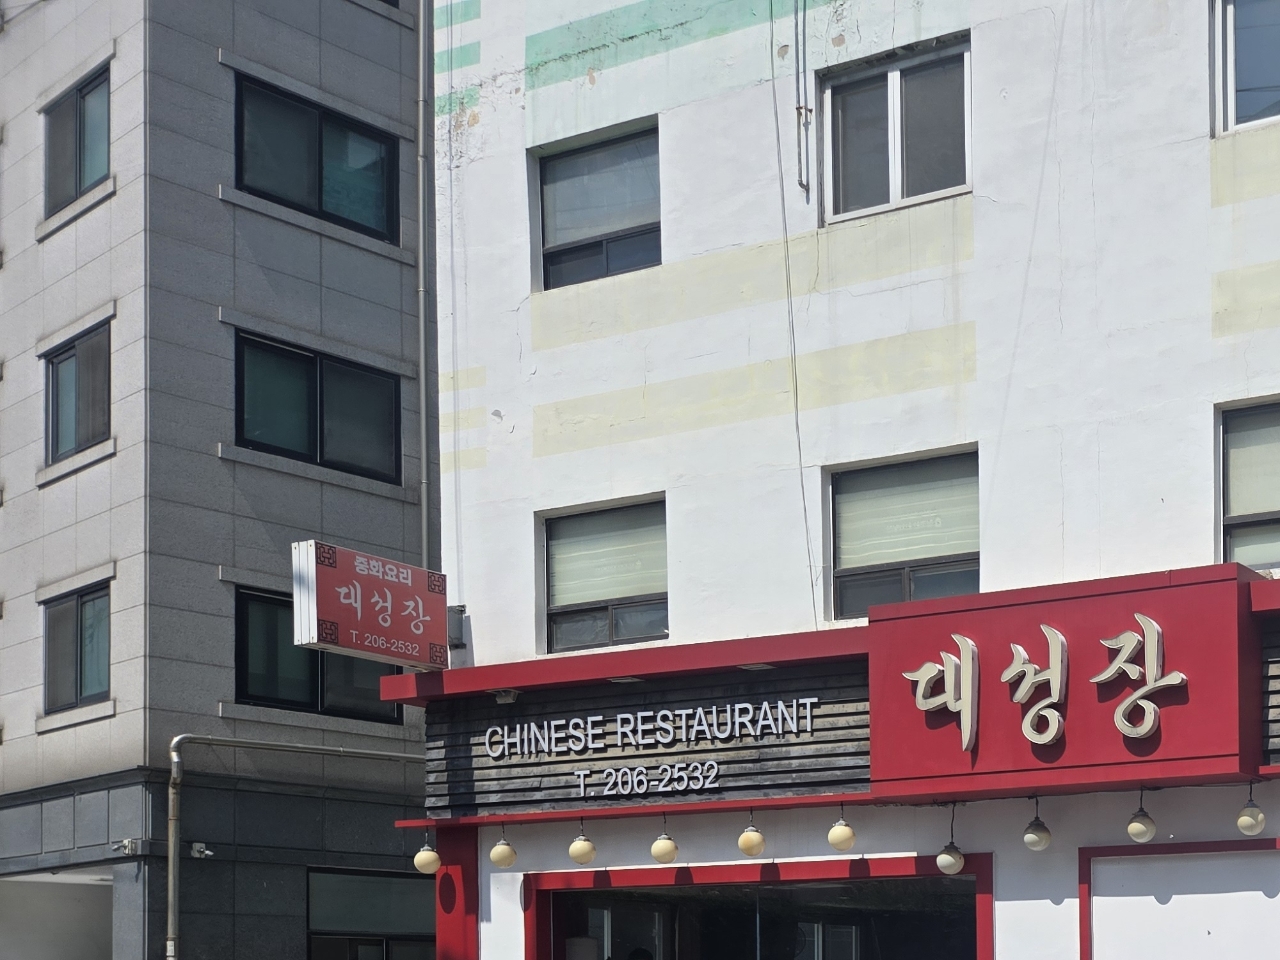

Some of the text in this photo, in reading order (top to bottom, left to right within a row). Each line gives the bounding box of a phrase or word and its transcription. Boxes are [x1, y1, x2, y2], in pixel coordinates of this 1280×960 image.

[354, 555, 412, 586] 중화요리
[335, 580, 431, 635] 대성장
[364, 633, 420, 656] 206-2532
[902, 613, 1188, 752] 대성장
[485, 698, 818, 758] CHINESE RESTAURANT
[603, 761, 719, 796] 206-2532
